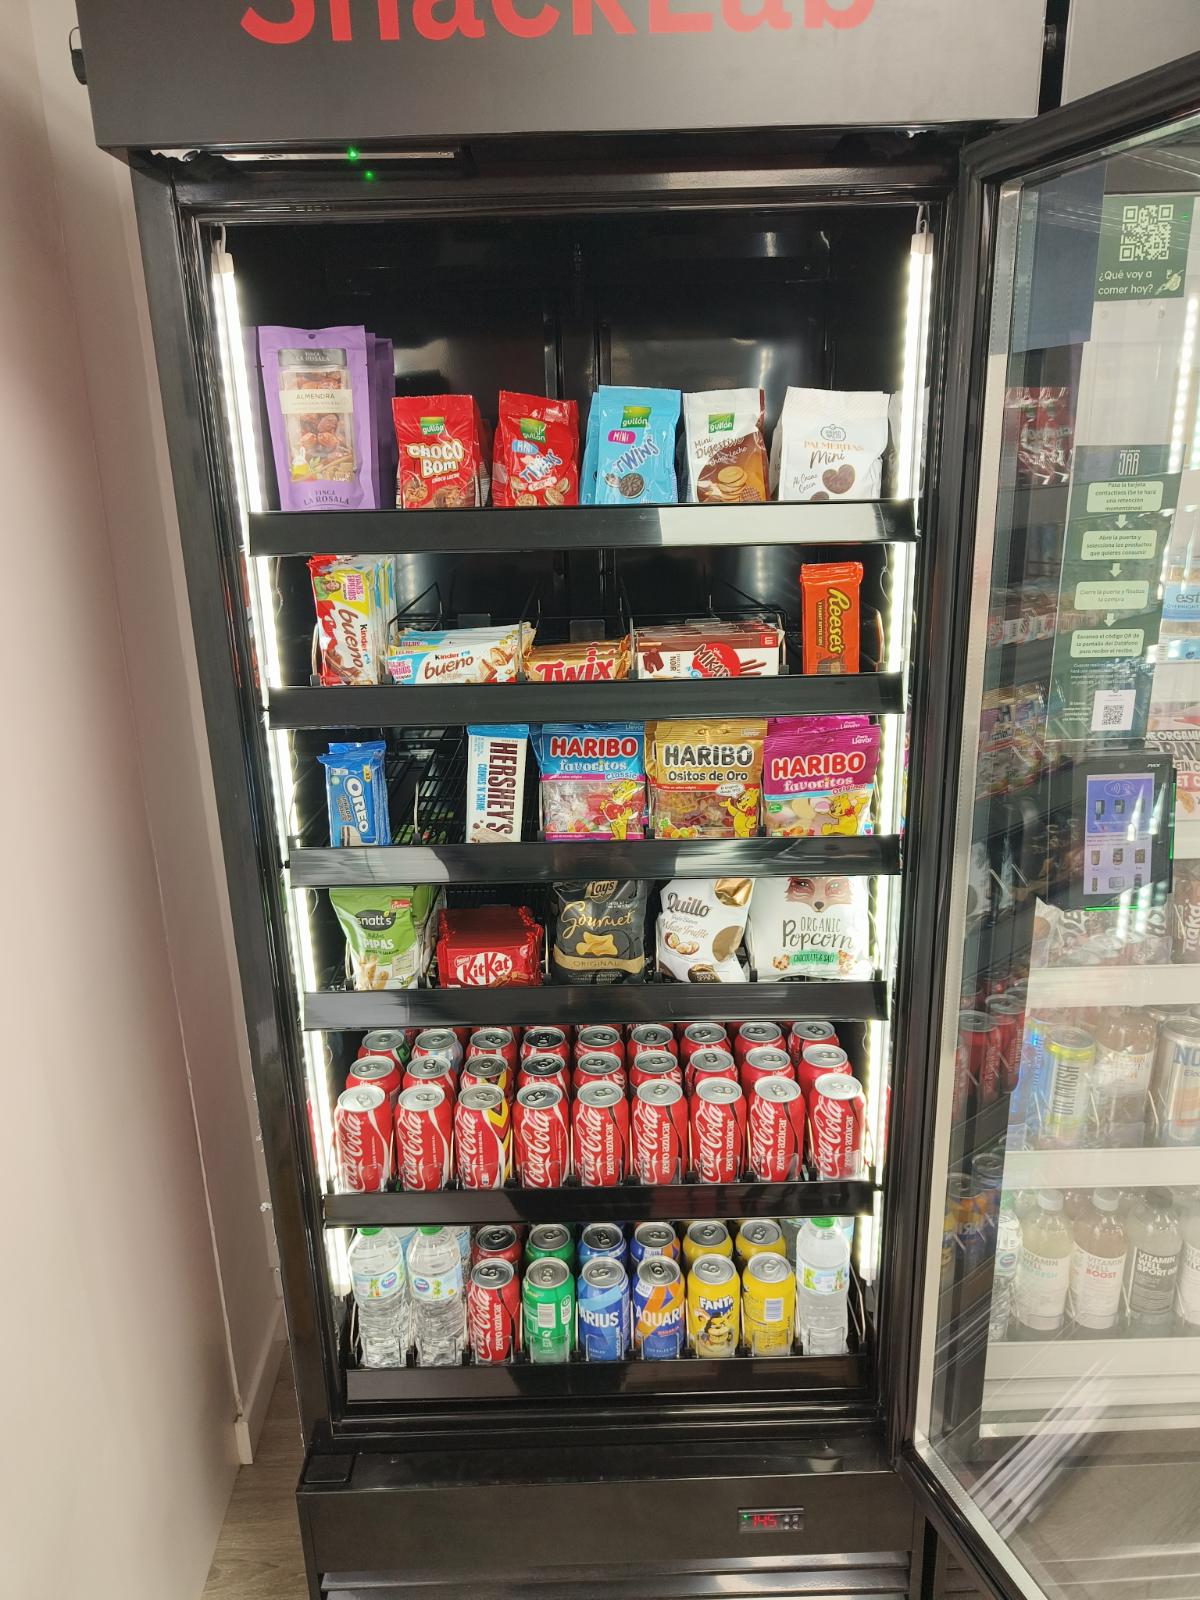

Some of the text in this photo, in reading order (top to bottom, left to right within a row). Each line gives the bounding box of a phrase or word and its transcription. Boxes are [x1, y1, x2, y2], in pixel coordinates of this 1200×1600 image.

[1098, 270, 1153, 281] ¿Qué voy a
[1098, 284, 1154, 295] comer hoy?
[338, 608, 364, 668] bueno
[424, 656, 474, 680] bueno
[550, 736, 638, 758] HARIBO
[663, 744, 755, 768] HARIBO
[559, 759, 628, 772] favoritos
[668, 770, 748, 781] Ositos de Oro
[771, 751, 866, 780] HARIBO
[486, 741, 518, 835] HERSHEY'S
[784, 776, 854, 793] favoritos
[346, 777, 369, 833] OREO
[667, 892, 712, 917] Quillo
[561, 900, 636, 939] Gourmet
[800, 916, 841, 933] ORGANIC
[782, 919, 854, 950] Popcorn
[462, 952, 511, 985] KitKat
[606, 1154, 615, 1176] zero
[661, 1153, 670, 1175] zero
[725, 1151, 734, 1172] zero
[777, 1149, 786, 1171] zero
[1138, 1250, 1176, 1264] VITAMIN
[1086, 1267, 1118, 1280] BOOST
